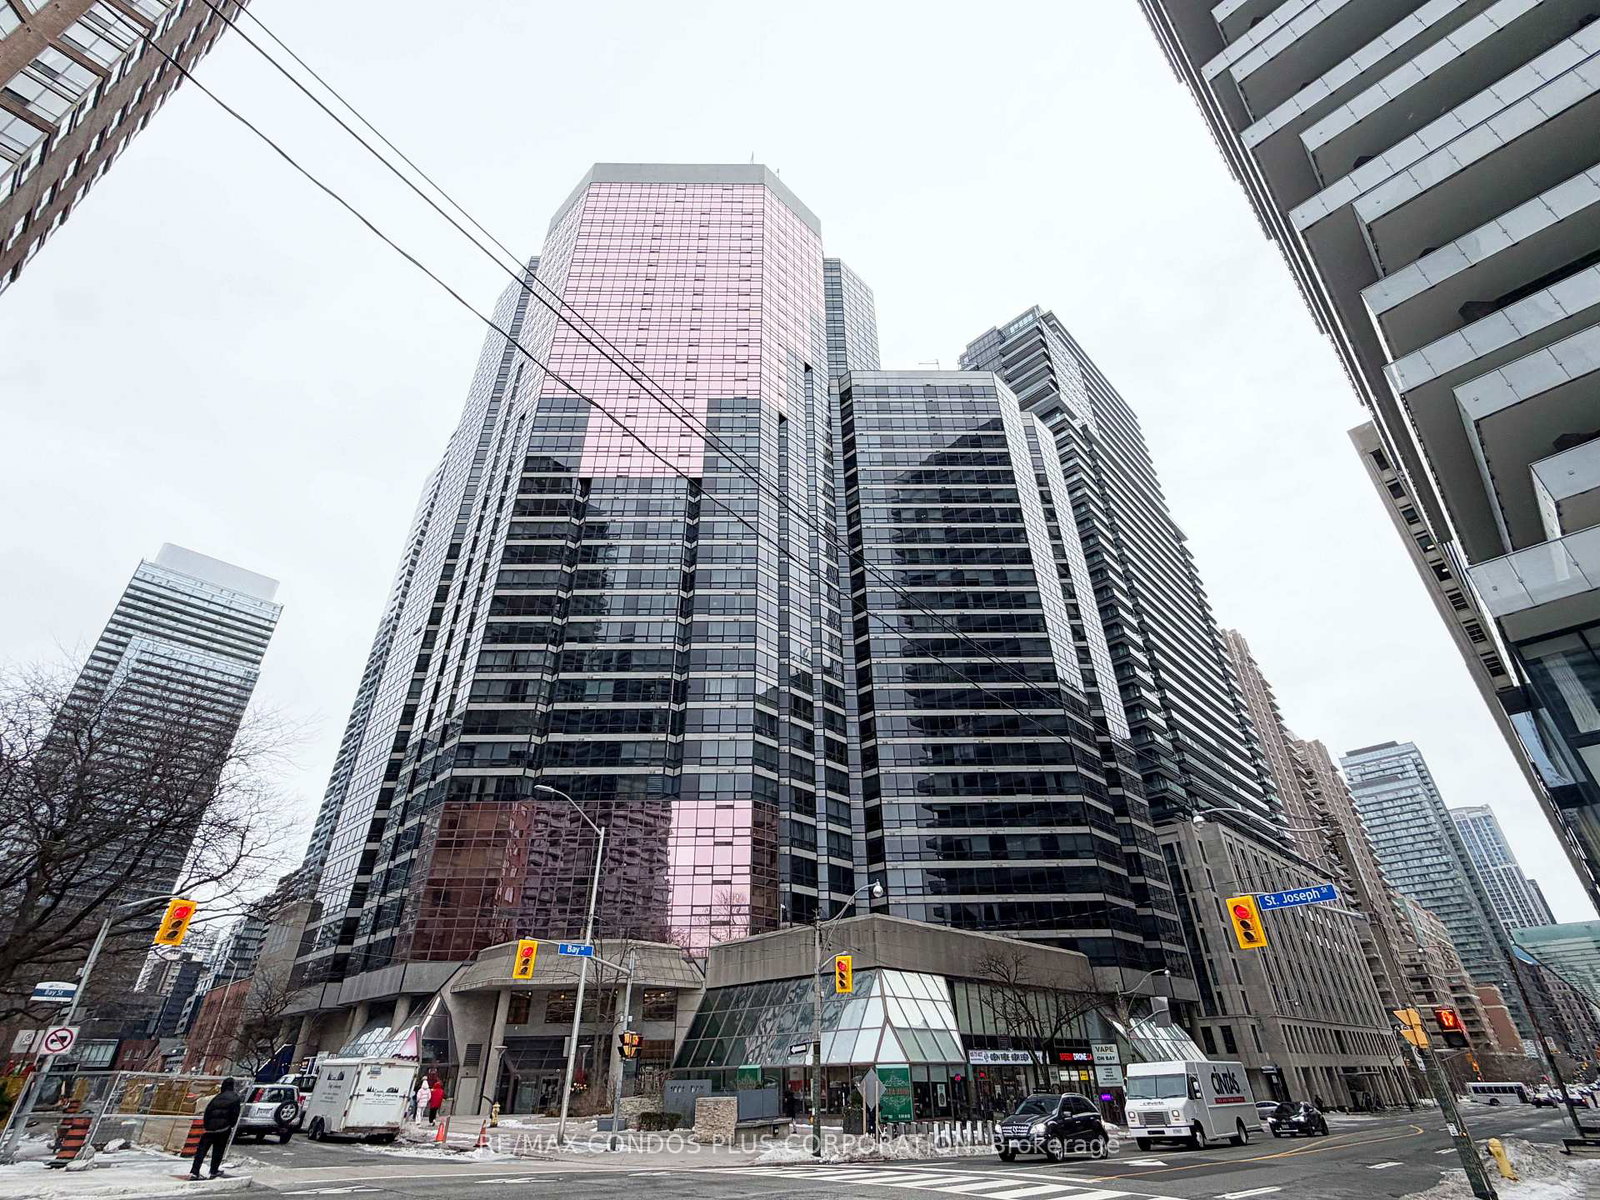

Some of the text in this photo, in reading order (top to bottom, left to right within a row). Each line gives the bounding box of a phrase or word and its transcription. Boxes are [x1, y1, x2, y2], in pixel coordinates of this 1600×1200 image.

[1264, 895, 1280, 906] St.
[1282, 889, 1321, 904] Joseph
[567, 945, 580, 955] Bay
